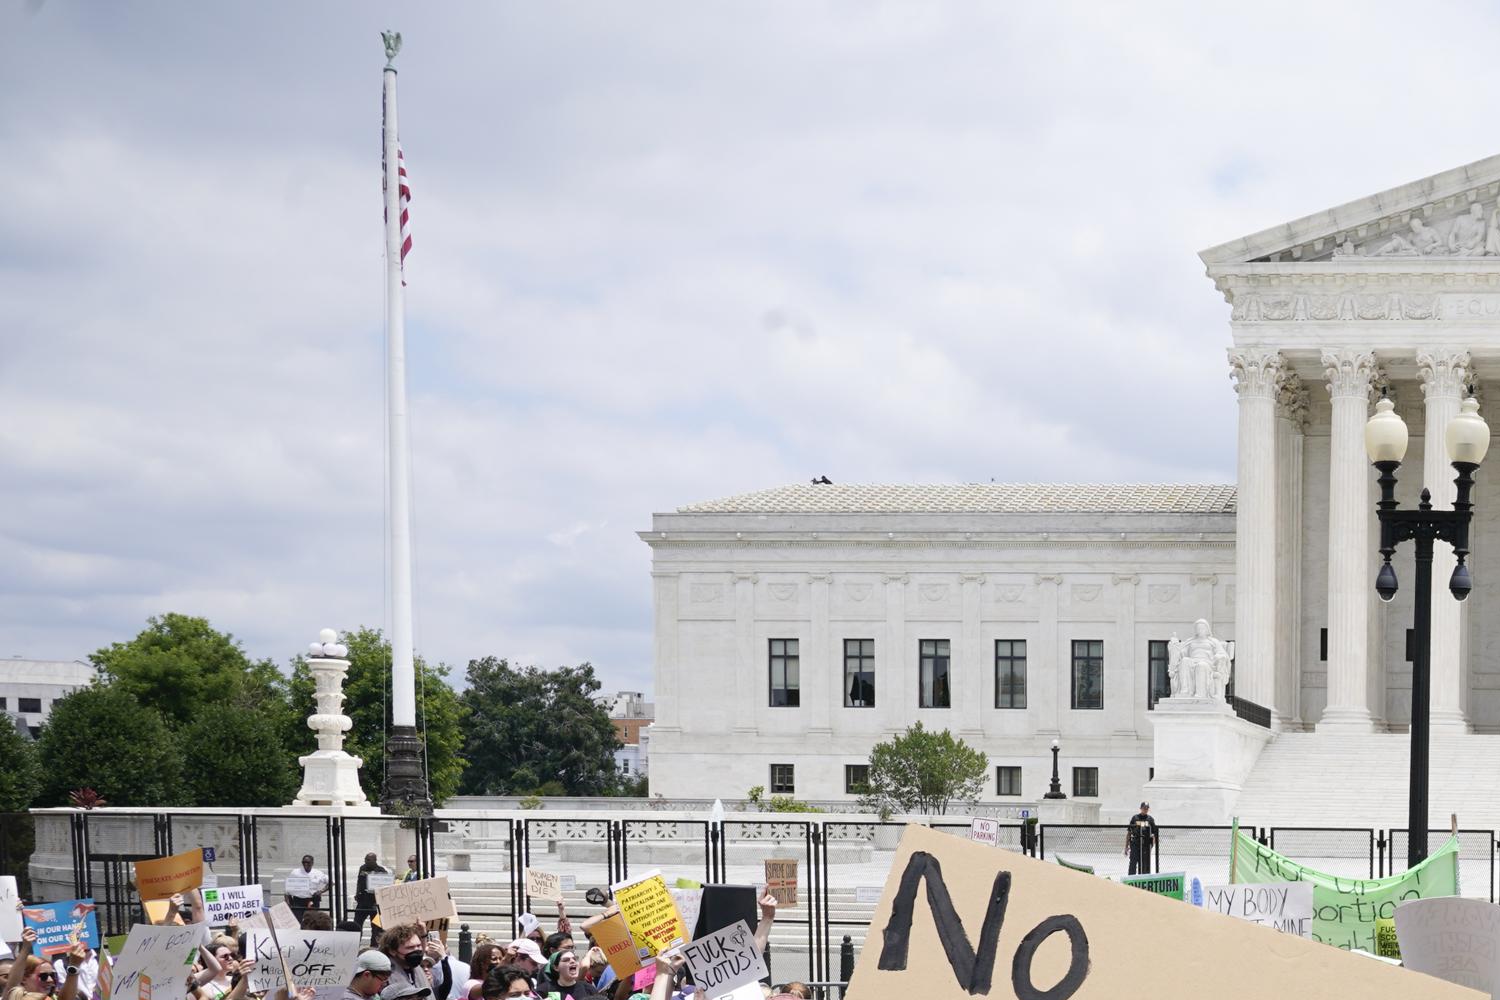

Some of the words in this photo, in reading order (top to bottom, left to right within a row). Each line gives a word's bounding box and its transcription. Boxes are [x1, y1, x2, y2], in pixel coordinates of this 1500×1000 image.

[979, 820, 990, 832] NO
[974, 830, 996, 842] PARKING
[767, 862, 784, 879] SUPREME
[786, 862, 798, 879] COURT
[529, 870, 559, 884] WOMEN
[535, 878, 555, 889] WILL
[228, 890, 246, 899] WILL
[531, 886, 549, 895] DIE
[208, 904, 222, 912] AID
[224, 902, 239, 910] AND
[241, 900, 260, 909] ABET
[646, 903, 655, 912] END
[657, 897, 667, 906] ONE
[1209, 890, 1235, 916] MY
[1243, 887, 1288, 916] BODY
[630, 910, 655, 926] WITHOUT
[656, 902, 674, 913] ENDING
[46, 925, 61, 933] OUR
[641, 920, 652, 929] THE
[48, 935, 63, 943] OUR
[653, 925, 676, 941] NOTHING
[684, 935, 735, 969] FUCK
[292, 963, 335, 976] OFF
[694, 946, 761, 992] SCOTUS!
